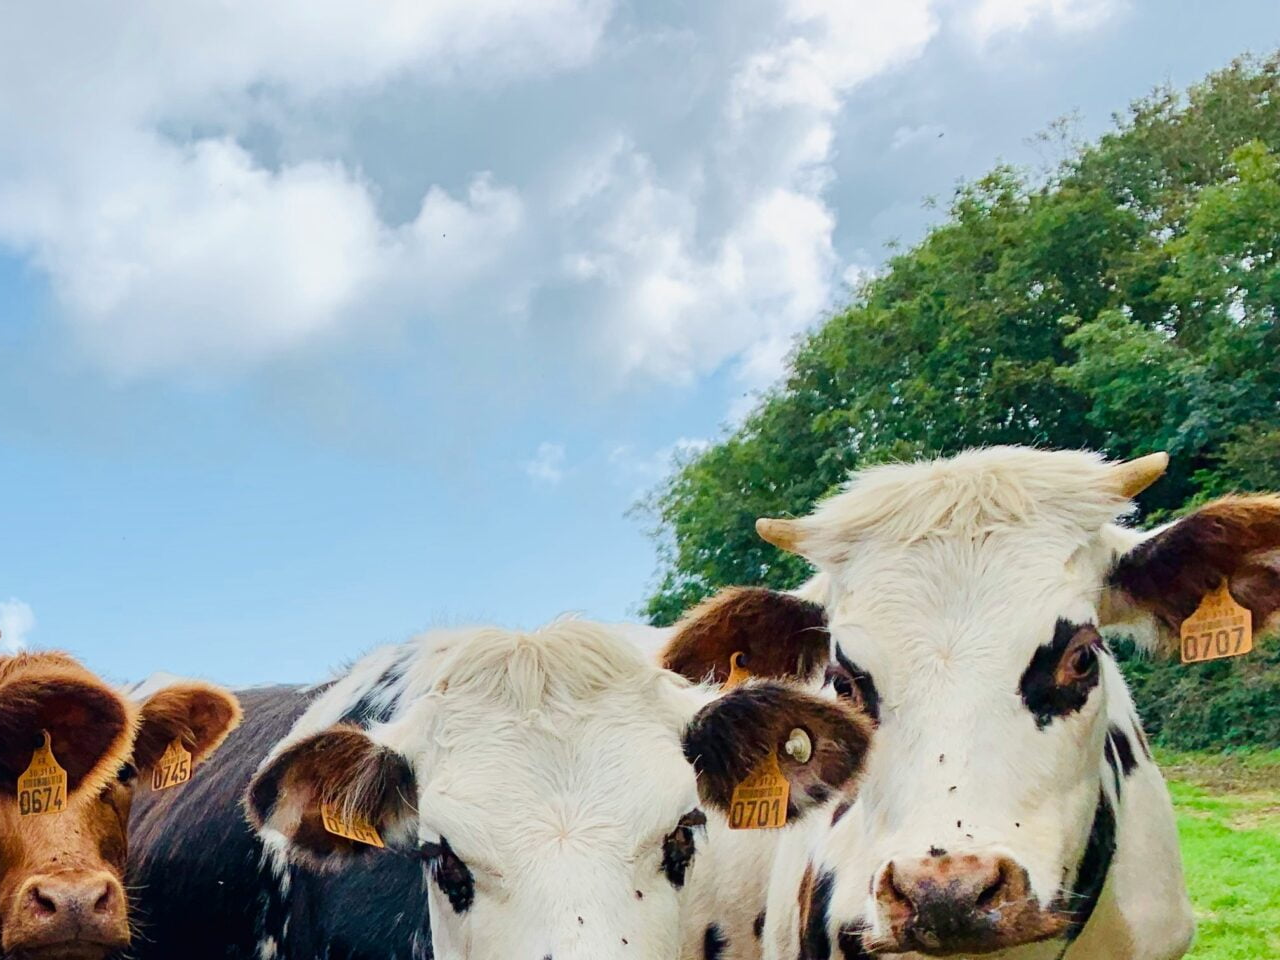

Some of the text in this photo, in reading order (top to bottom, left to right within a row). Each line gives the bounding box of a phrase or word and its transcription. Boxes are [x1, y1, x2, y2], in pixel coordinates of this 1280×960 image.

[1183, 626, 1245, 660] 0707
[153, 759, 187, 789] 0745
[20, 785, 62, 815] 0674
[731, 799, 780, 828] 0701
